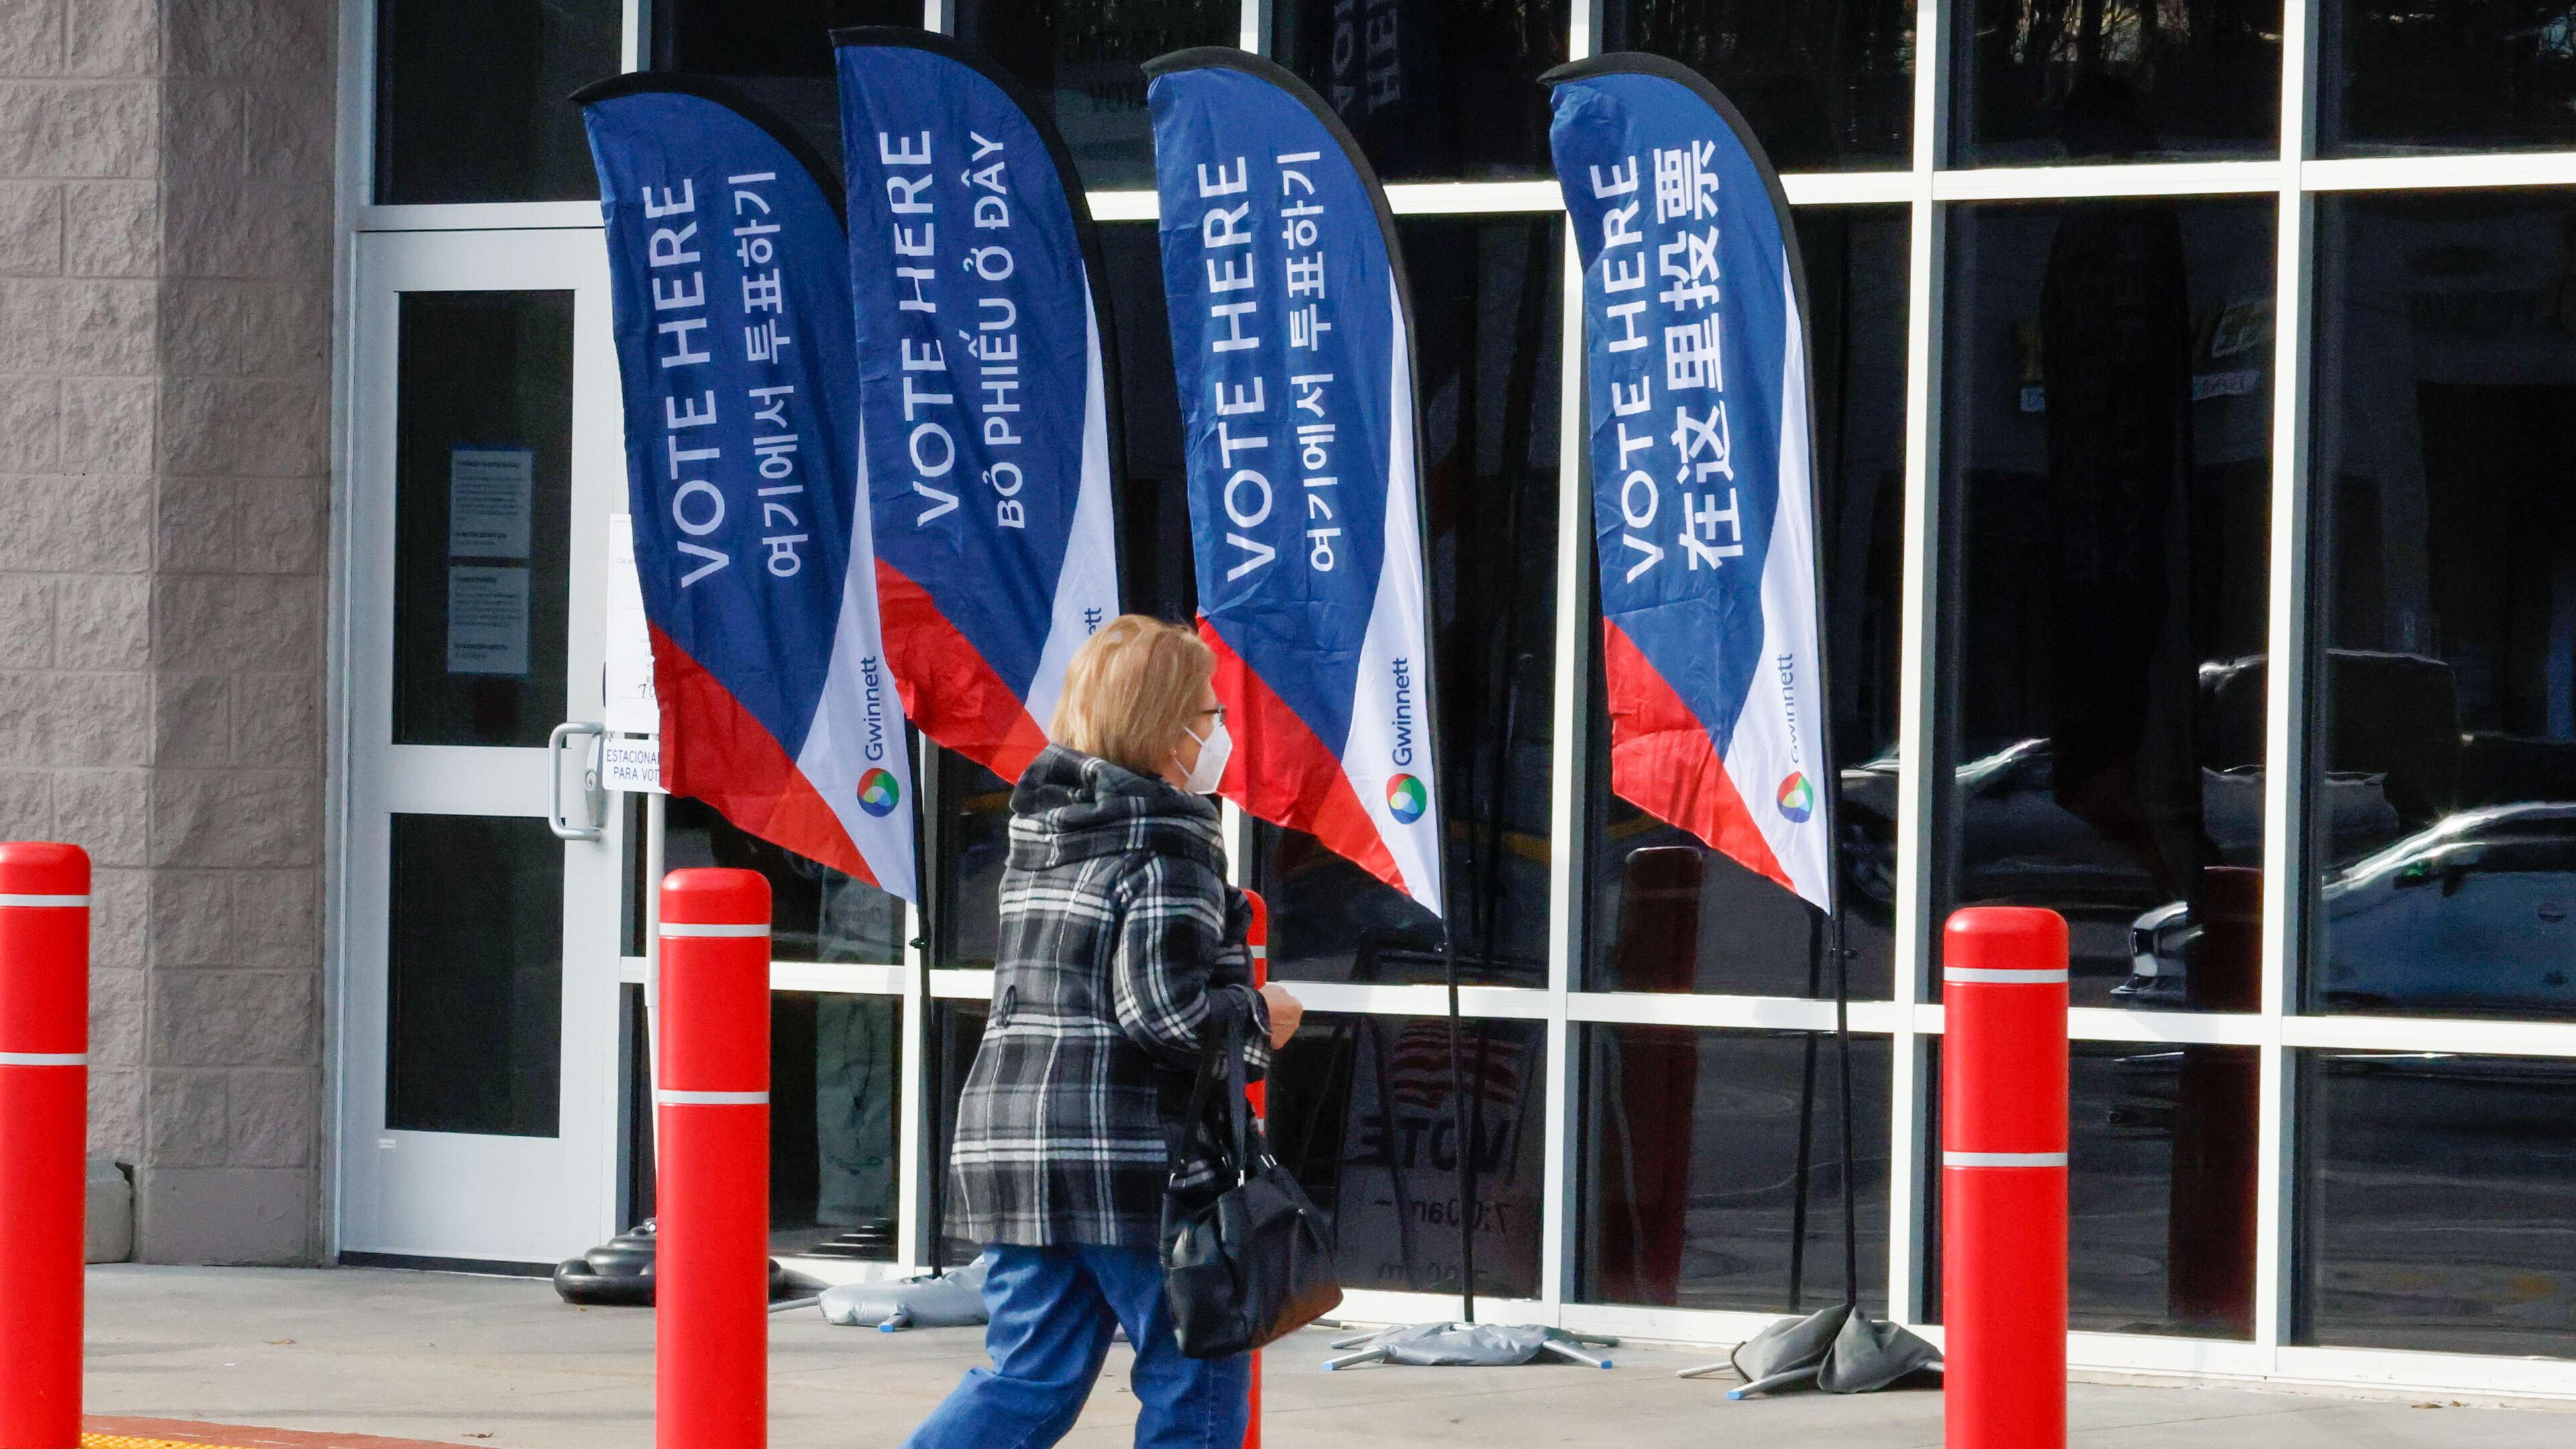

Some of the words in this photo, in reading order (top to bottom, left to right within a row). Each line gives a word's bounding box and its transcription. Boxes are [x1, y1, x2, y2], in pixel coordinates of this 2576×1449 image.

[642, 178, 710, 368] HERE
[728, 172, 790, 364] 투표하기
[879, 131, 936, 313] HERE
[961, 131, 1009, 229] ĐÂY
[963, 246, 1014, 281] Ở
[1197, 156, 1260, 353] HERE
[1277, 152, 1331, 351] 투표하기
[1589, 156, 1648, 353] HERE
[902, 338, 959, 527] VOTE
[959, 298, 1021, 445] PHIẾU
[1652, 140, 1744, 571] 在这里投票
[665, 390, 729, 588] VOTE
[749, 385, 808, 577] 여기에서
[982, 462, 1025, 529] BỎ
[1215, 376, 1276, 582] VOTE
[1291, 374, 1341, 572] 여기에서
[1611, 374, 1664, 584] VOTE
[606, 749, 660, 765] ESTACIONA
[613, 766, 638, 781] PARA
[860, 655, 883, 761] Gwinnett
[1391, 657, 1413, 767] Gwinnett
[1776, 653, 1799, 764] Gwinnett
